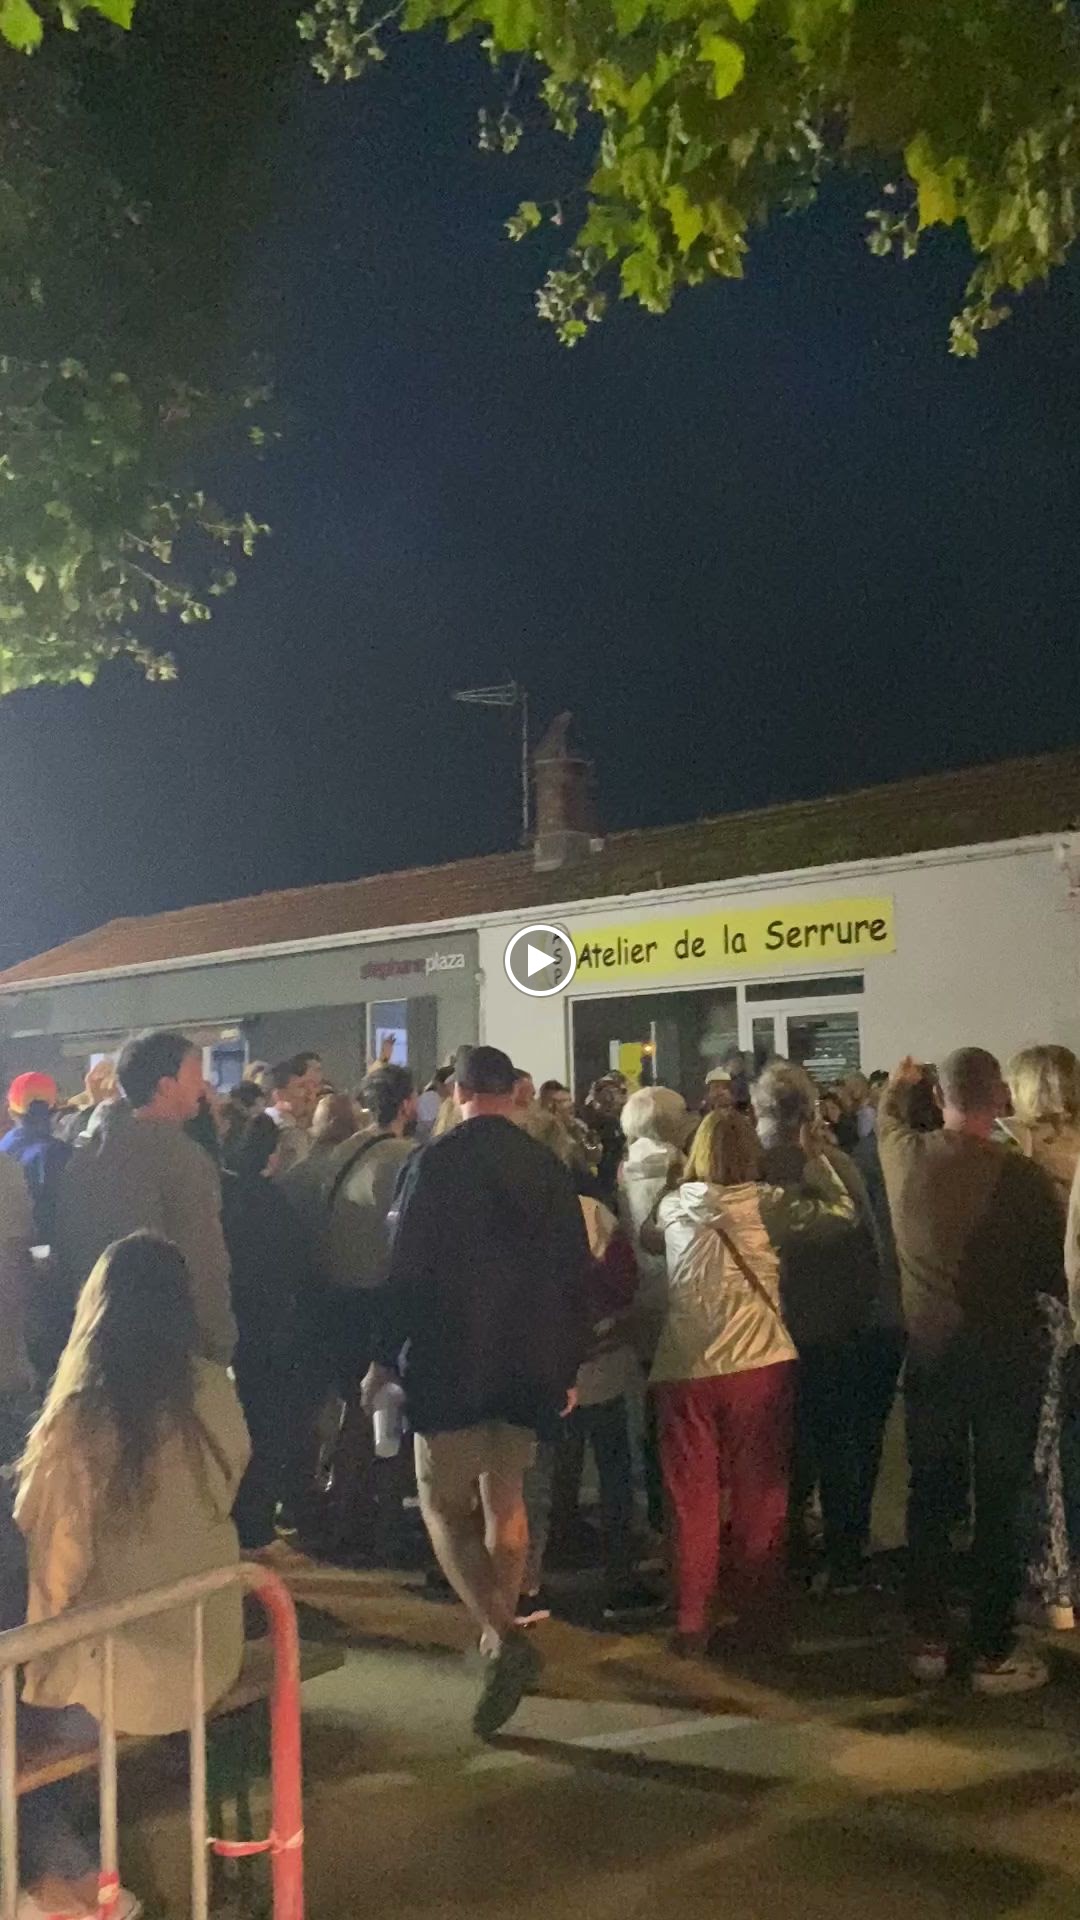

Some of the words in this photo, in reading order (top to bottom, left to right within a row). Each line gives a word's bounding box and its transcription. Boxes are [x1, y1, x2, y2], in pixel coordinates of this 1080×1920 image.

[577, 937, 657, 969] Atelier
[674, 929, 706, 959] de
[723, 924, 747, 954] la
[765, 917, 887, 951] Serrure
[425, 951, 465, 976] plaza
